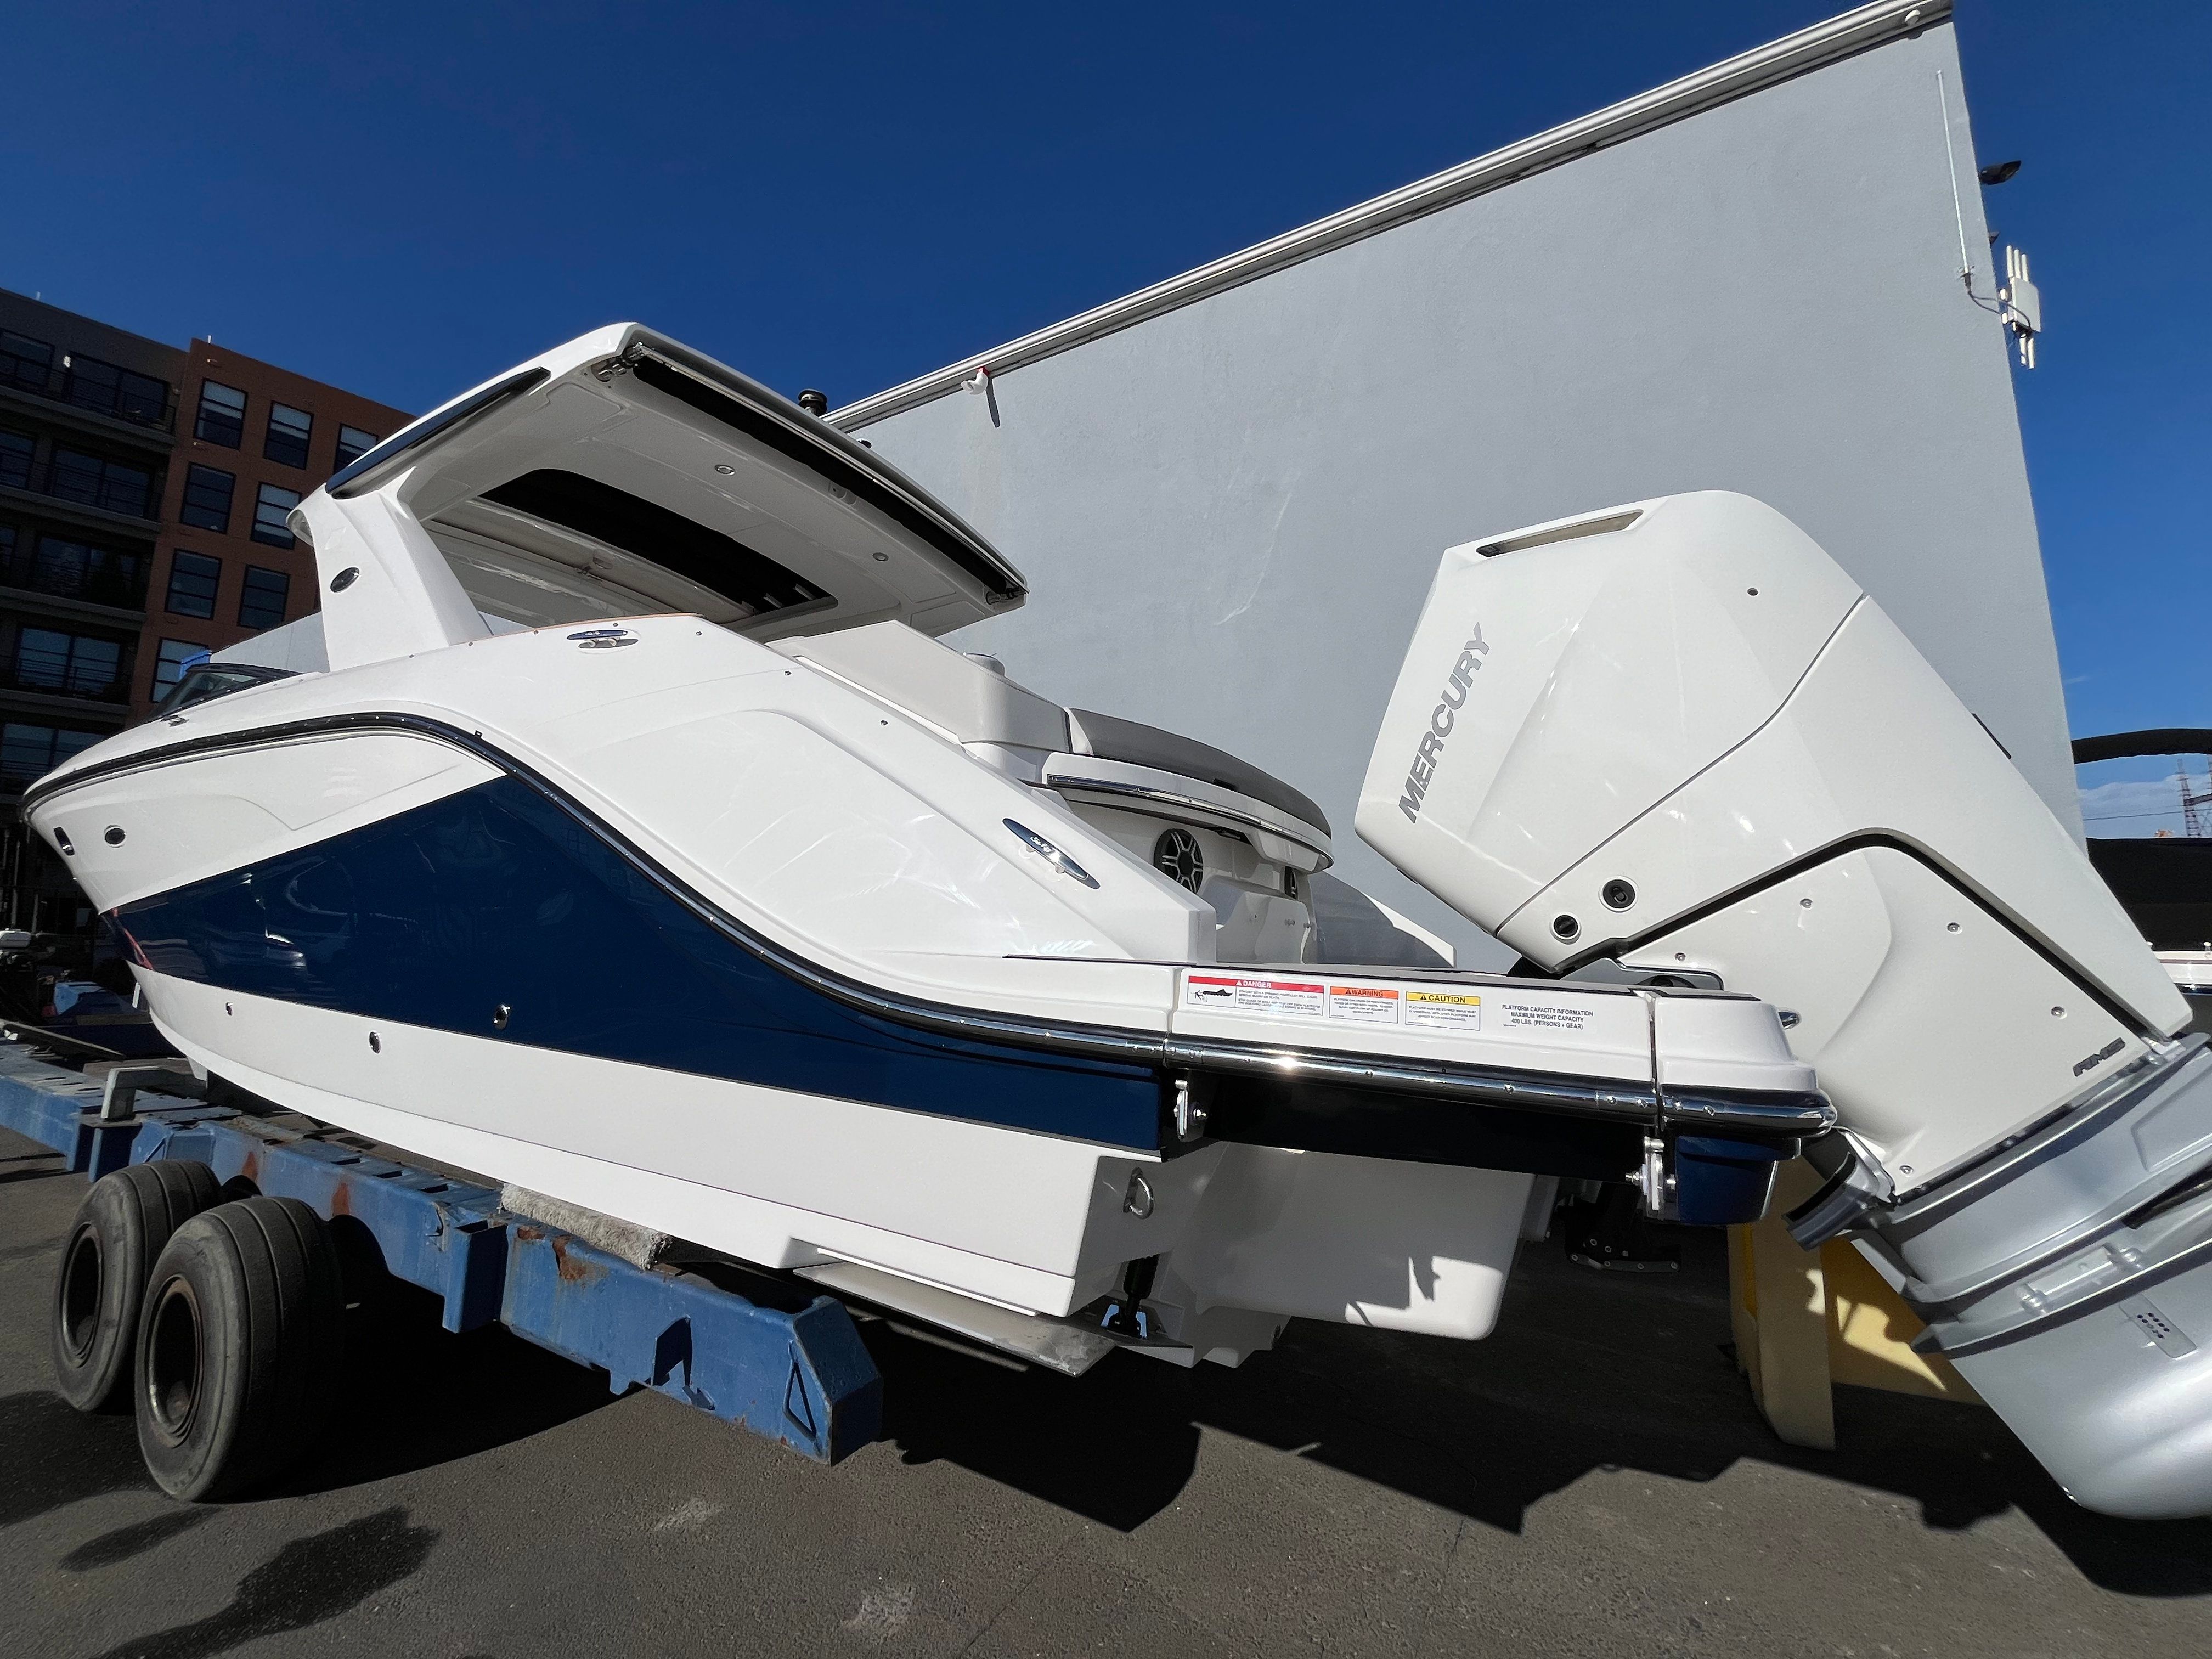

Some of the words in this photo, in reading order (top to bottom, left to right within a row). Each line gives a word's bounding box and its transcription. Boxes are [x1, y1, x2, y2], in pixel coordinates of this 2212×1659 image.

[1399, 622, 1489, 823] MERCURY
[1243, 980, 1271, 989] DANGER
[1429, 995, 1465, 1003] CAUTION
